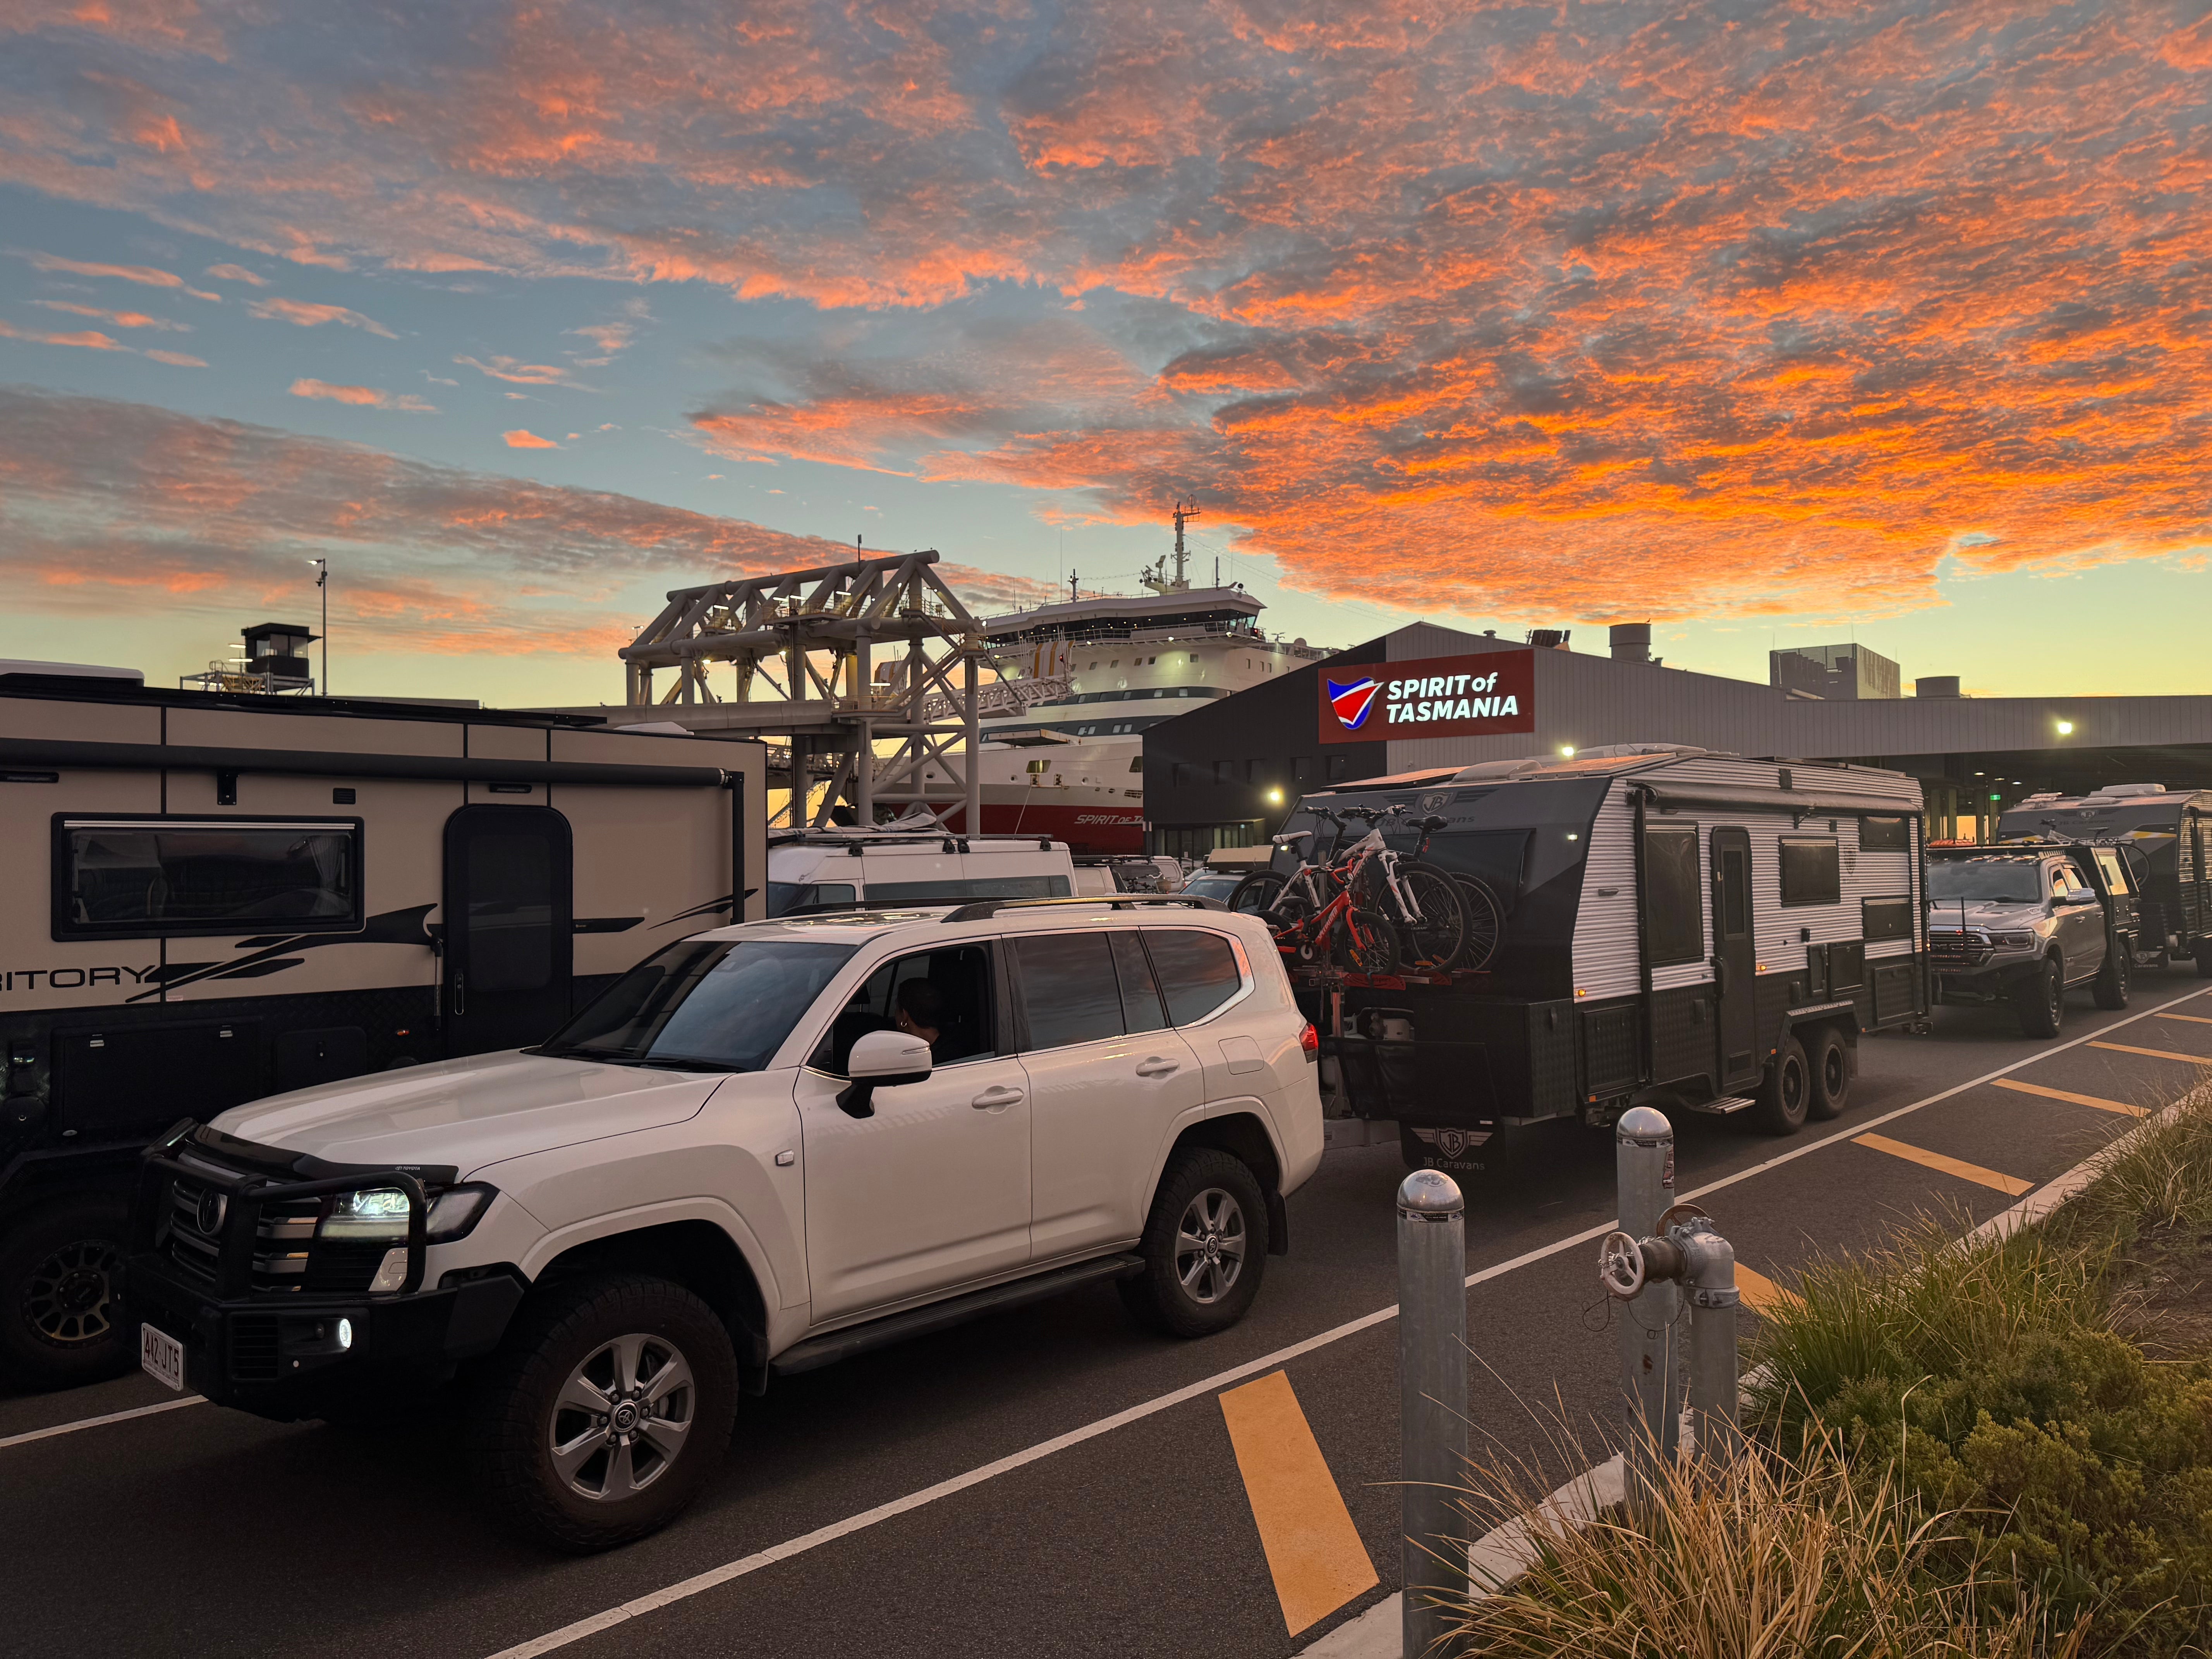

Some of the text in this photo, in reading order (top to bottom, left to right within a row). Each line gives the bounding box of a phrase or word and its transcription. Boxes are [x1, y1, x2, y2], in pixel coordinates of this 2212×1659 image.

[1387, 672, 1498, 700] SPIRIT of
[1386, 695, 1518, 723] TASMANIA
[1423, 796, 1444, 812] JB
[1074, 814, 1119, 824] SPIRIT
[0, 965, 155, 991] ITORY
[1443, 1133, 1461, 1152] JB
[1423, 1157, 1485, 1170] JB Caravans
